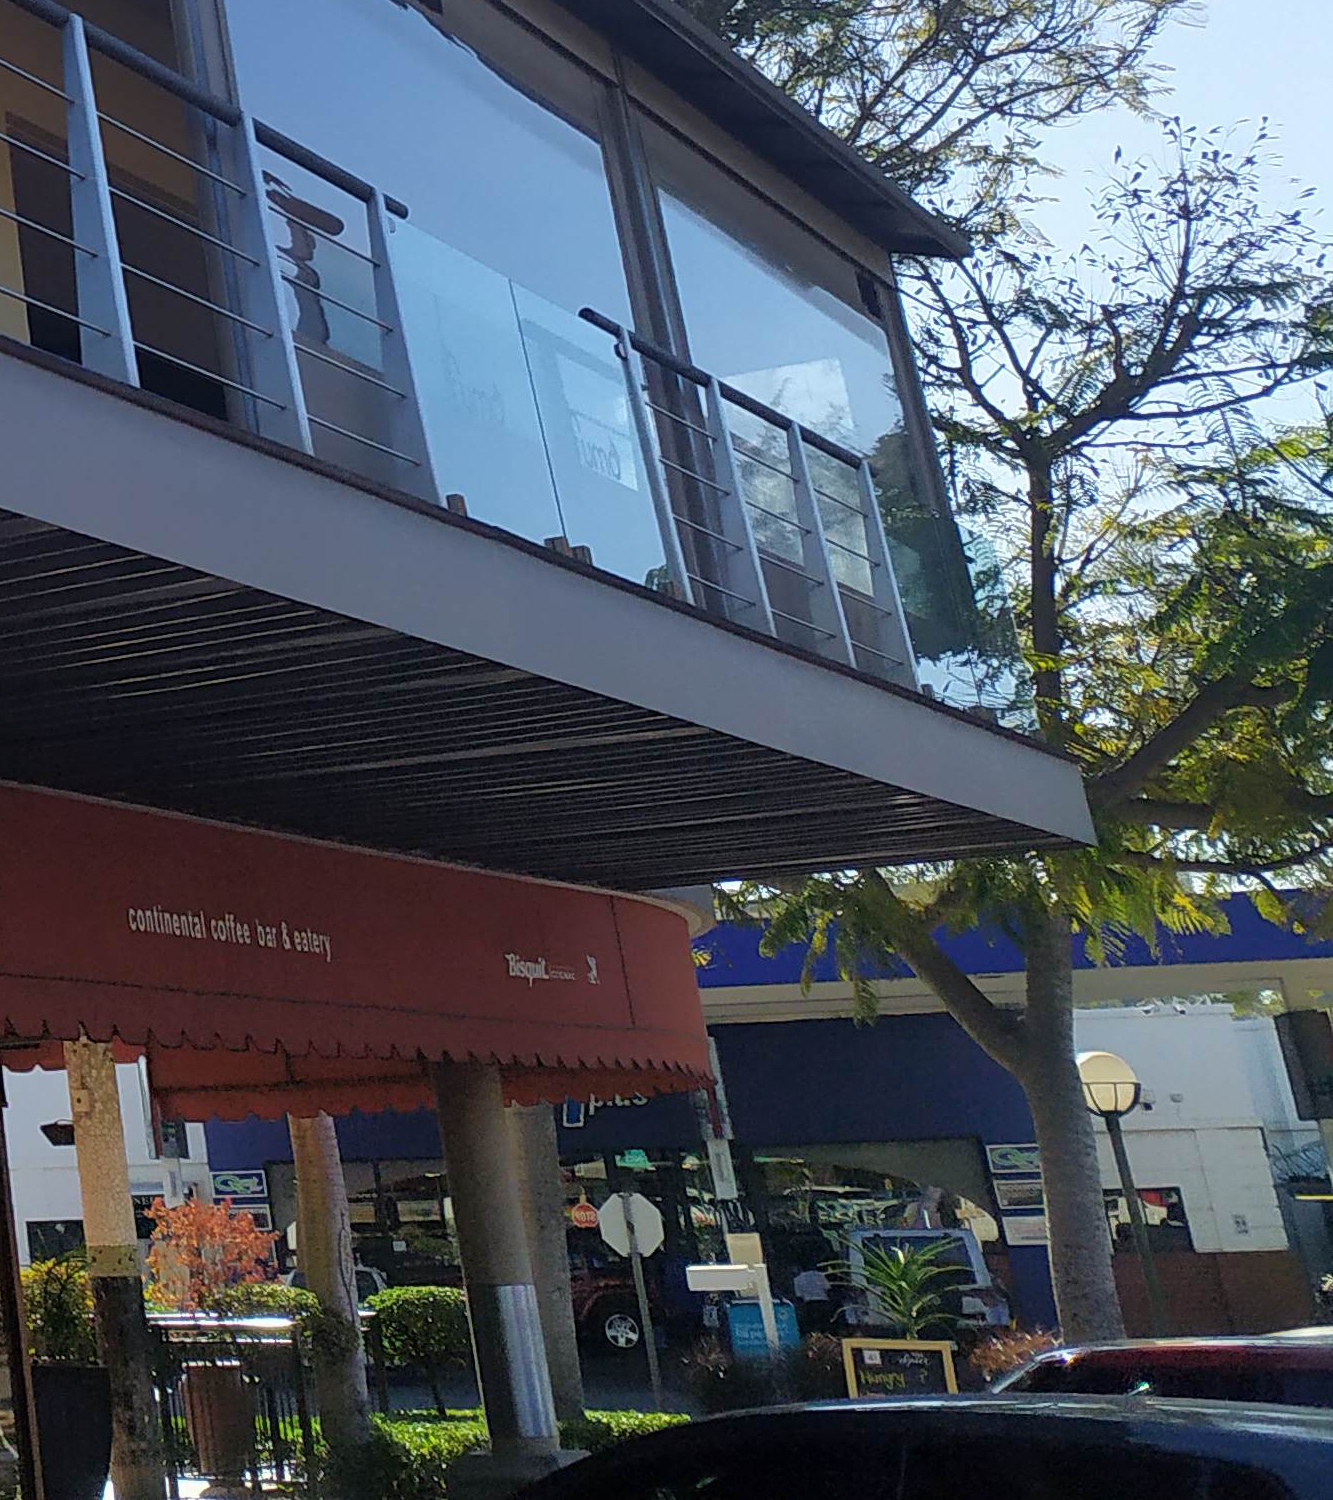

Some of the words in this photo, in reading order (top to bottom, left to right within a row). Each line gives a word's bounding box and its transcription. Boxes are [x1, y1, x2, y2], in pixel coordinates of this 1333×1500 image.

[128, 905, 207, 939] continental
[210, 913, 252, 945] coffee
[255, 918, 278, 949] bar
[281, 921, 291, 951] &
[293, 928, 332, 963] eatery
